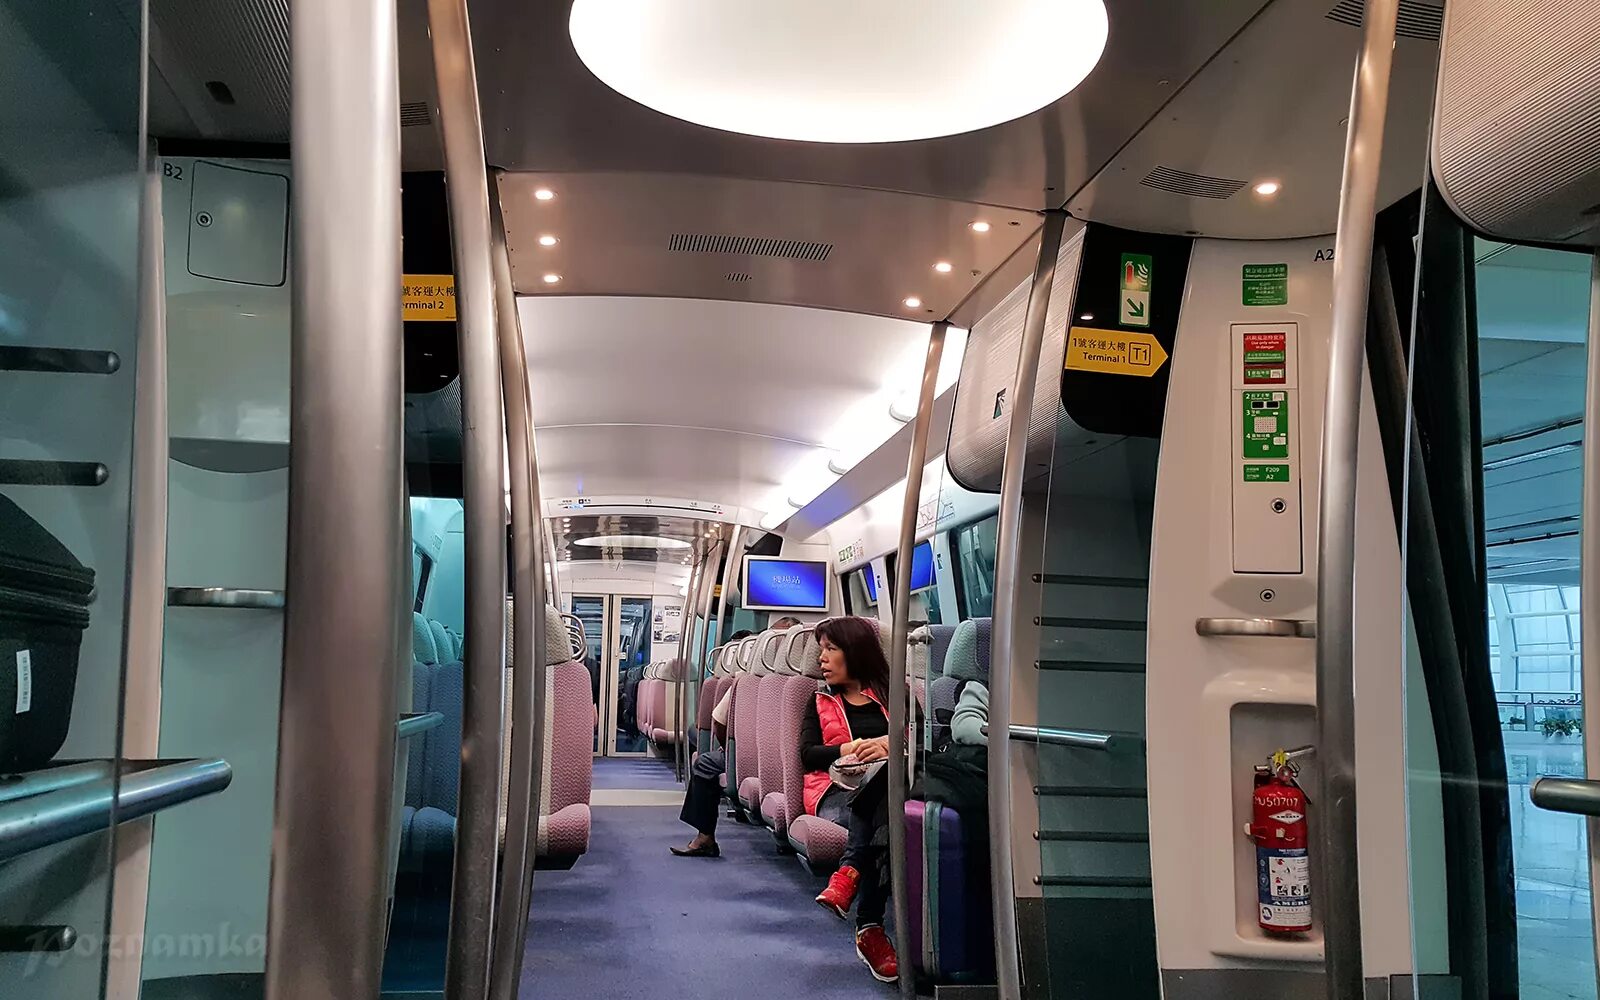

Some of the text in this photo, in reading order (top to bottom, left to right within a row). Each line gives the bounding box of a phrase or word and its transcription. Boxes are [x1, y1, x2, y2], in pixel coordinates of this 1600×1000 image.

[163, 162, 183, 181] B2
[1313, 248, 1335, 262] A2
[403, 300, 444, 309] rminal 2
[1073, 337, 1126, 353] 1號客運大樓
[1082, 351, 1126, 363] Terminal 1
[1132, 347, 1148, 361] T1
